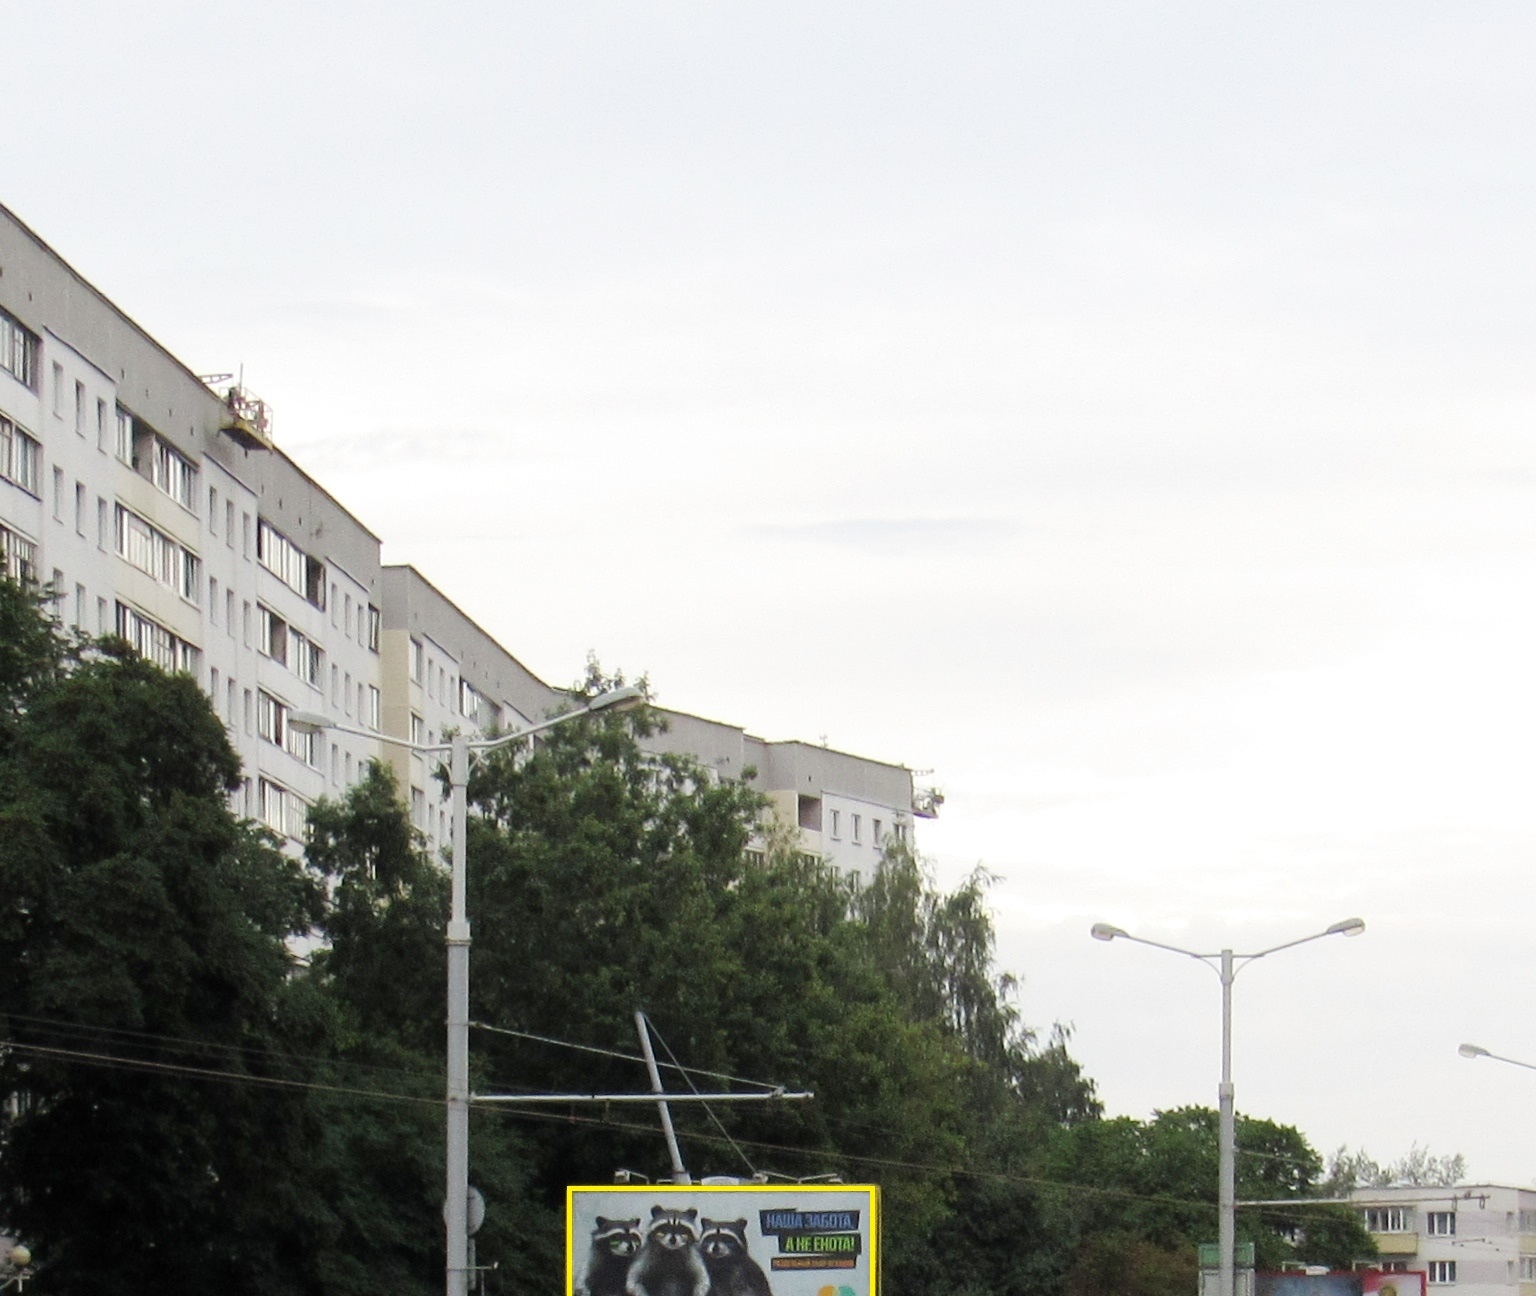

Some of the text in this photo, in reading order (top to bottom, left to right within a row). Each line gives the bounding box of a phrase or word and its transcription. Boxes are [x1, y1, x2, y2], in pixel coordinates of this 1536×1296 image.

[766, 1212, 804, 1229] НАША
[785, 1235, 856, 1252] А НЕ ЕНОТА!
